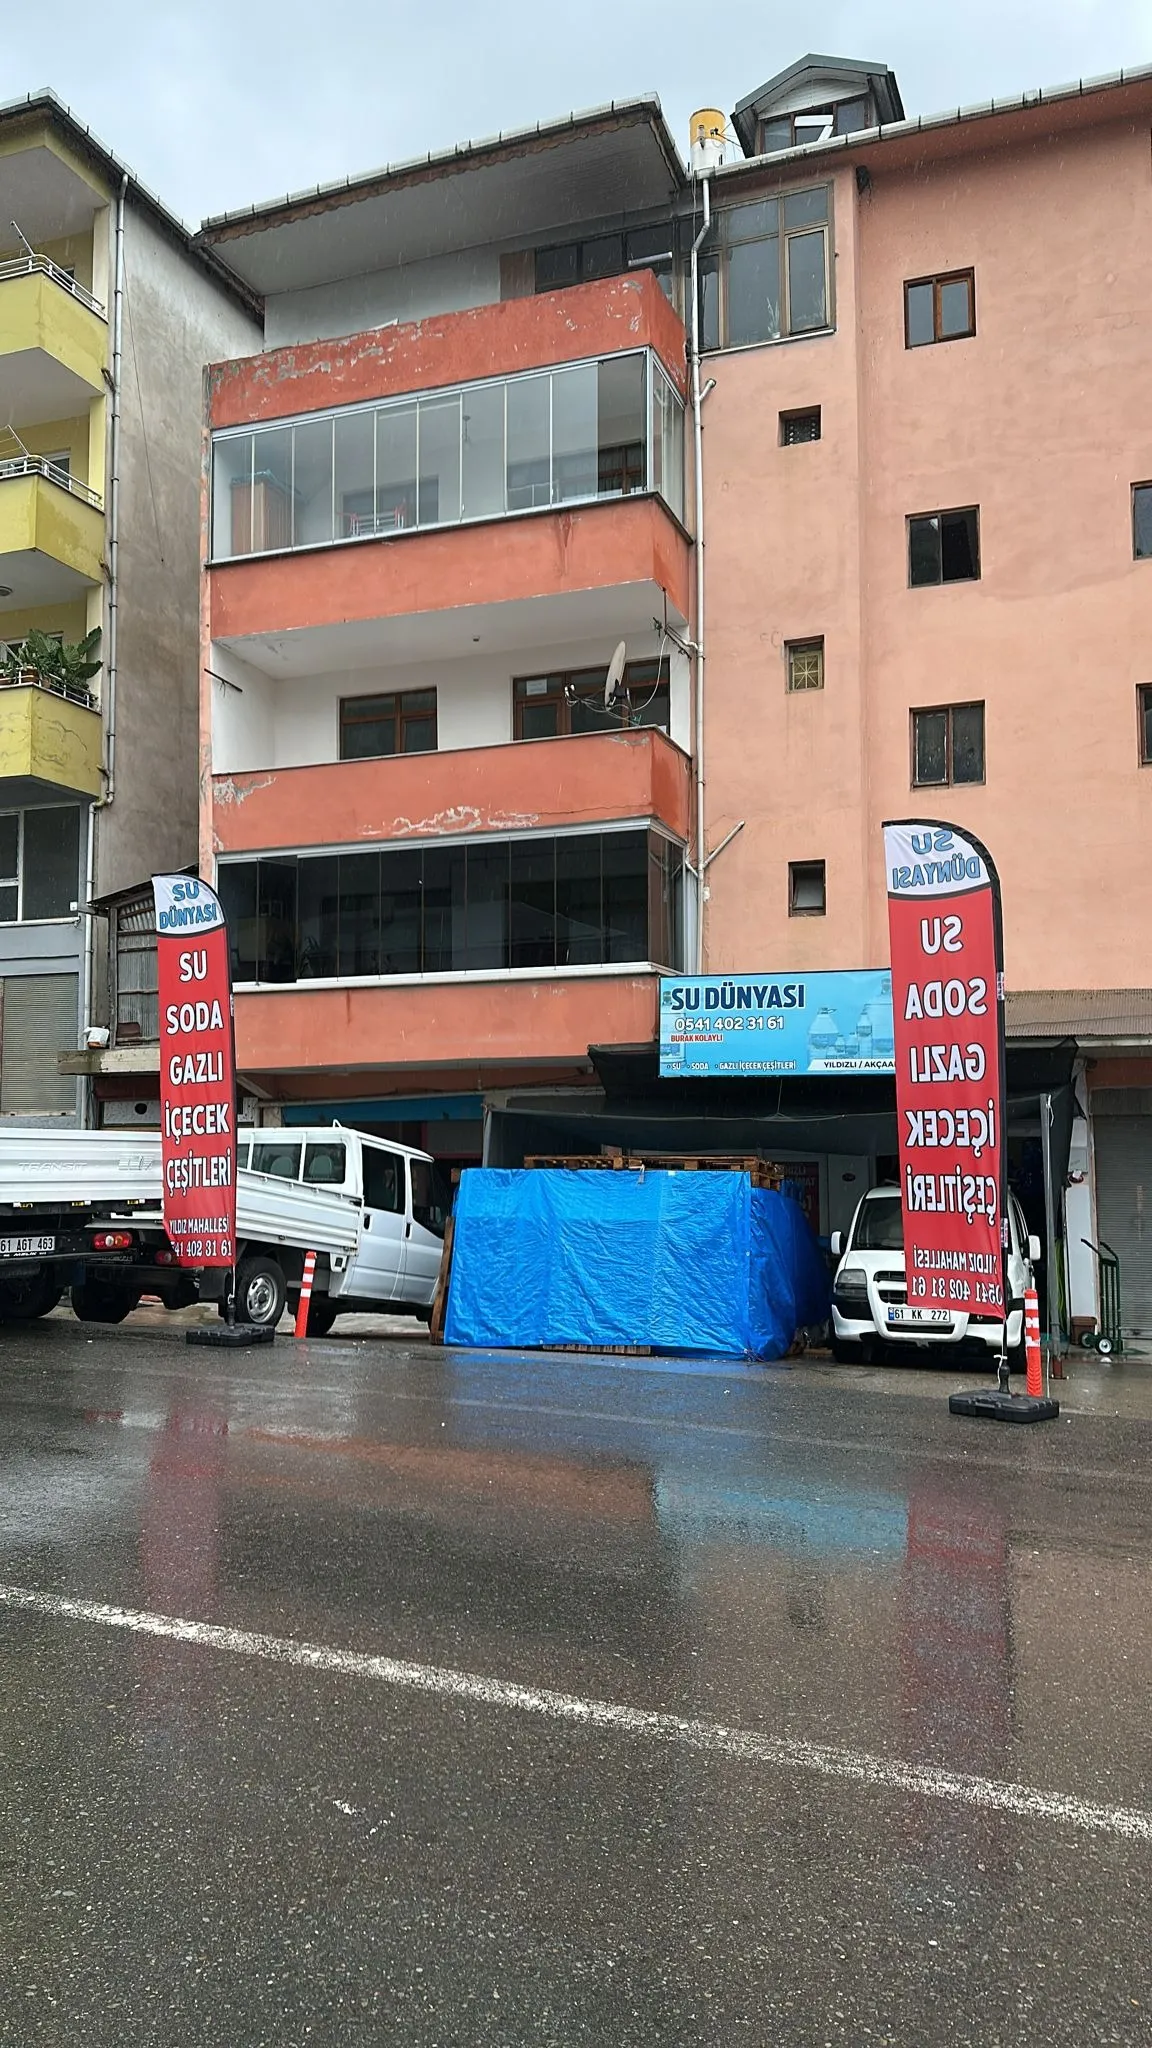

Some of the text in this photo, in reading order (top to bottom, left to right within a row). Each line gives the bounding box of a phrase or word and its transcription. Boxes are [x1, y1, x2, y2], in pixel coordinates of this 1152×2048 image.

[172, 881, 200, 902] SU
[159, 903, 218, 930] DÜNYASI
[179, 949, 208, 982] SU
[671, 981, 805, 1011] SU DÜNYASI
[165, 999, 224, 1035] SODA
[675, 1016, 784, 1031] 0541 402 31 61
[694, 1034, 723, 1042] KOLAYLI
[169, 1051, 223, 1086] GAZLI
[719, 1062, 738, 1070] GAZLI
[739, 1060, 762, 1072] İÇECEK
[762, 1060, 796, 1072] ÇEŞİTLERİ
[864, 1061, 896, 1069] AKÇAA
[164, 1100, 230, 1145] İÇECEK
[165, 1146, 232, 1198] ÇEŞİTLERİ
[169, 1213, 230, 1235] YILDIZ MAHALLESİ
[0, 1237, 53, 1252] 61 AGT 463
[186, 1240, 203, 1257] 402
[205, 1240, 217, 1257] 31
[221, 1239, 233, 1257] 61
[894, 1310, 948, 1321] 61 KK 272
